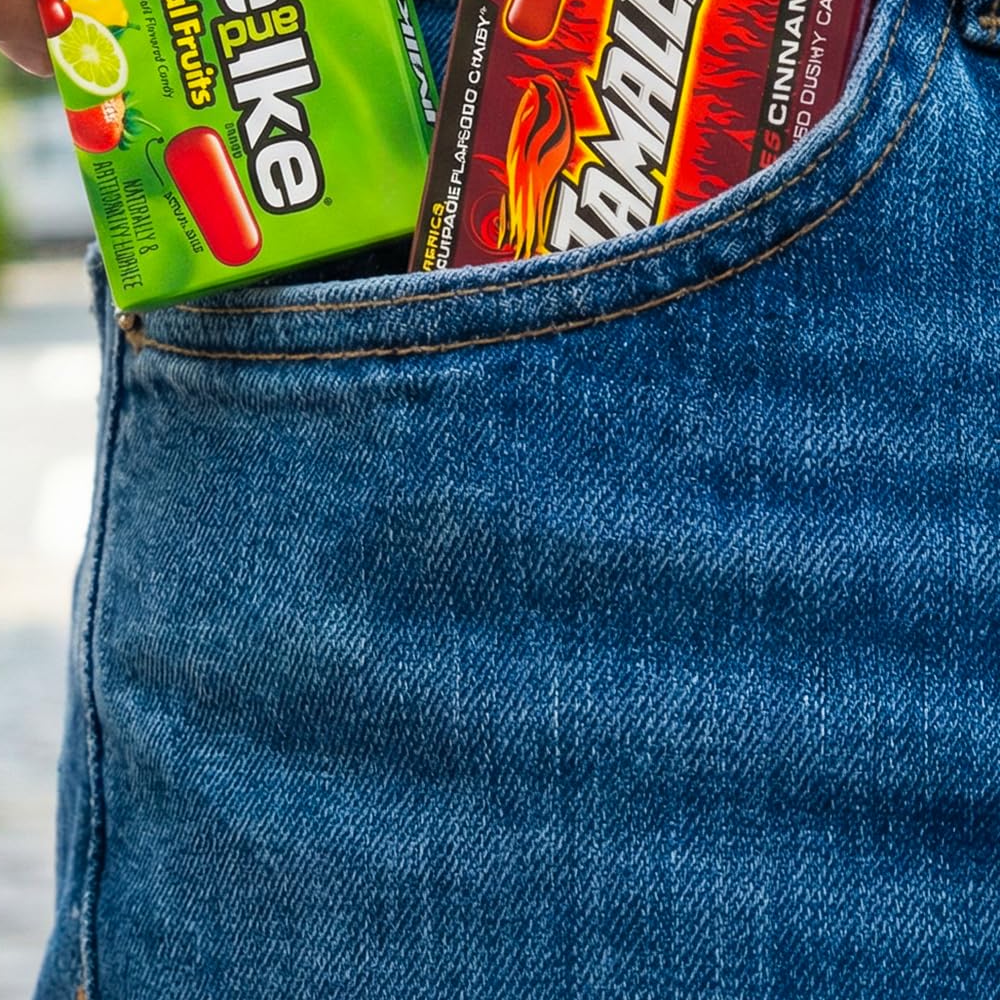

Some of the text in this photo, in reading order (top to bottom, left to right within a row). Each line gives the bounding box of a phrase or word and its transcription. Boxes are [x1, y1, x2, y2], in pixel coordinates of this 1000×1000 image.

[172, 17, 215, 106] Fruits
[216, 3, 300, 59] and
[225, 35, 320, 210] Ike
